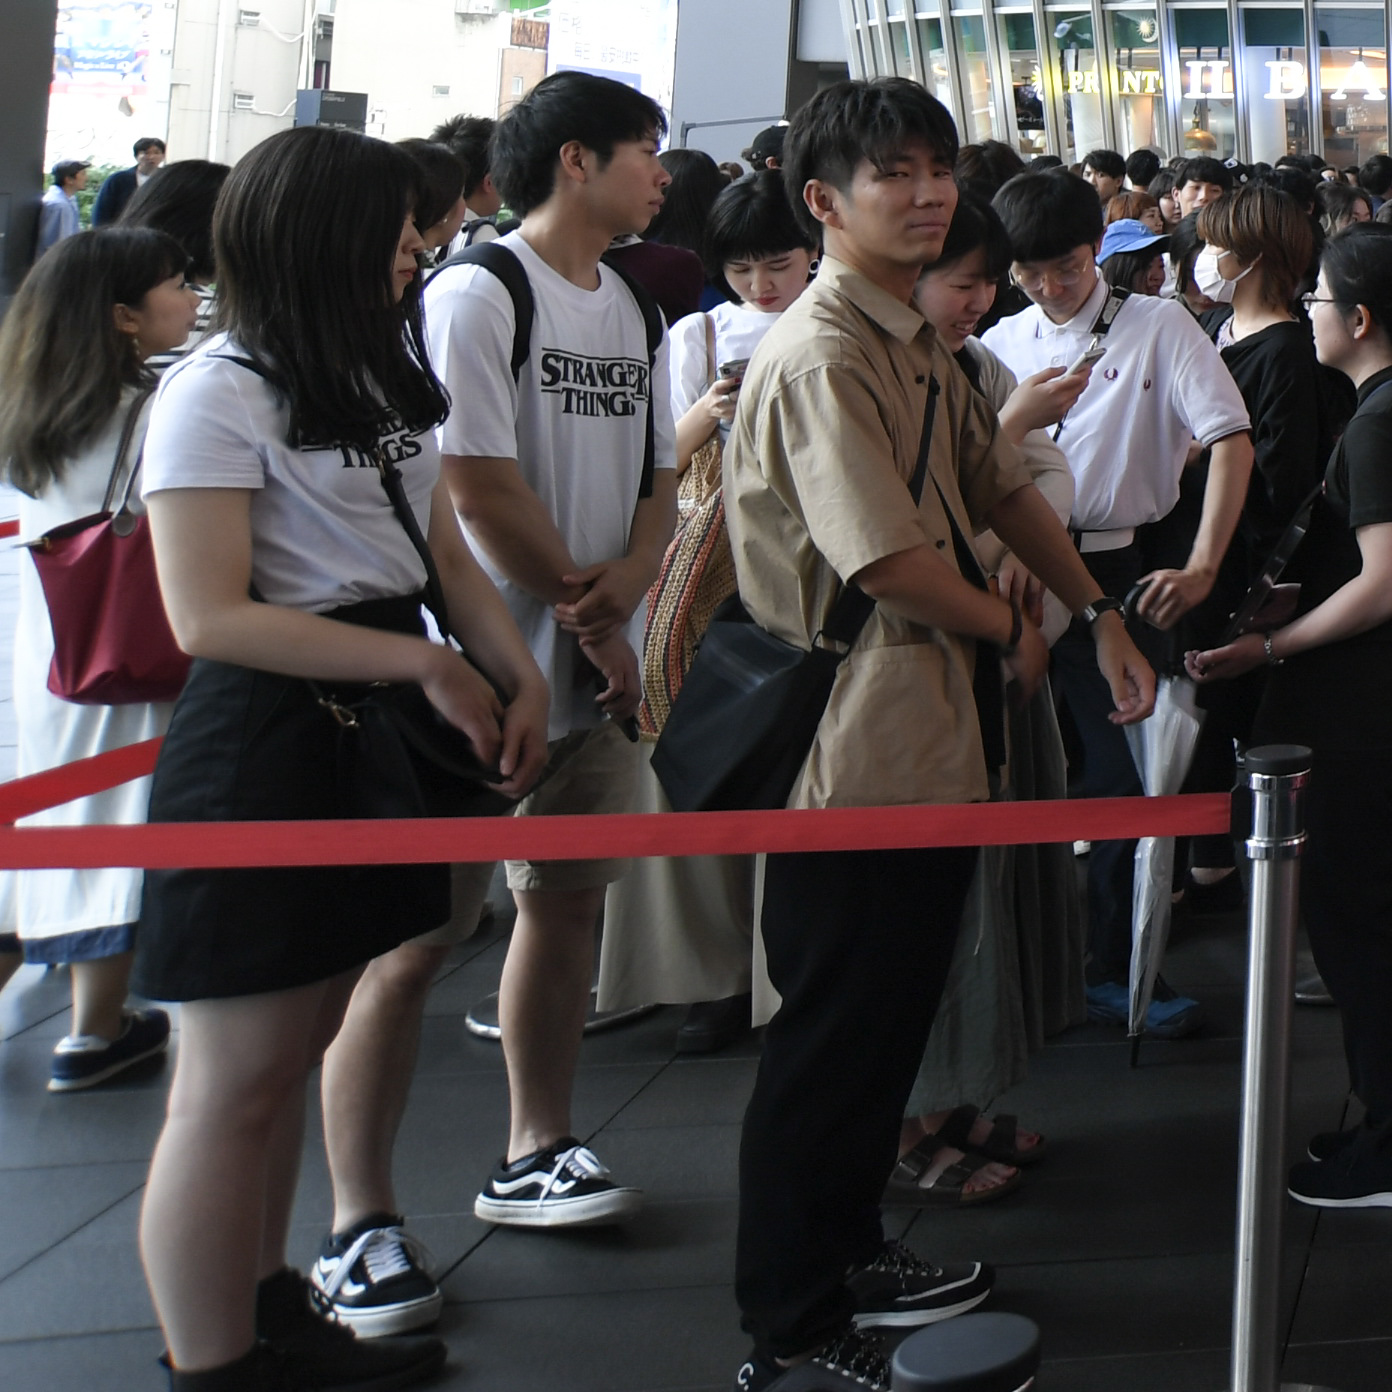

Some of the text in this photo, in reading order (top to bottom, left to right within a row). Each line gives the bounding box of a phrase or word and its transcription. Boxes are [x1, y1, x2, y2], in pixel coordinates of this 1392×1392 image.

[1067, 70, 1163, 94] PRNT
[541, 352, 648, 400] STRANGER
[334, 432, 422, 468] THGS
